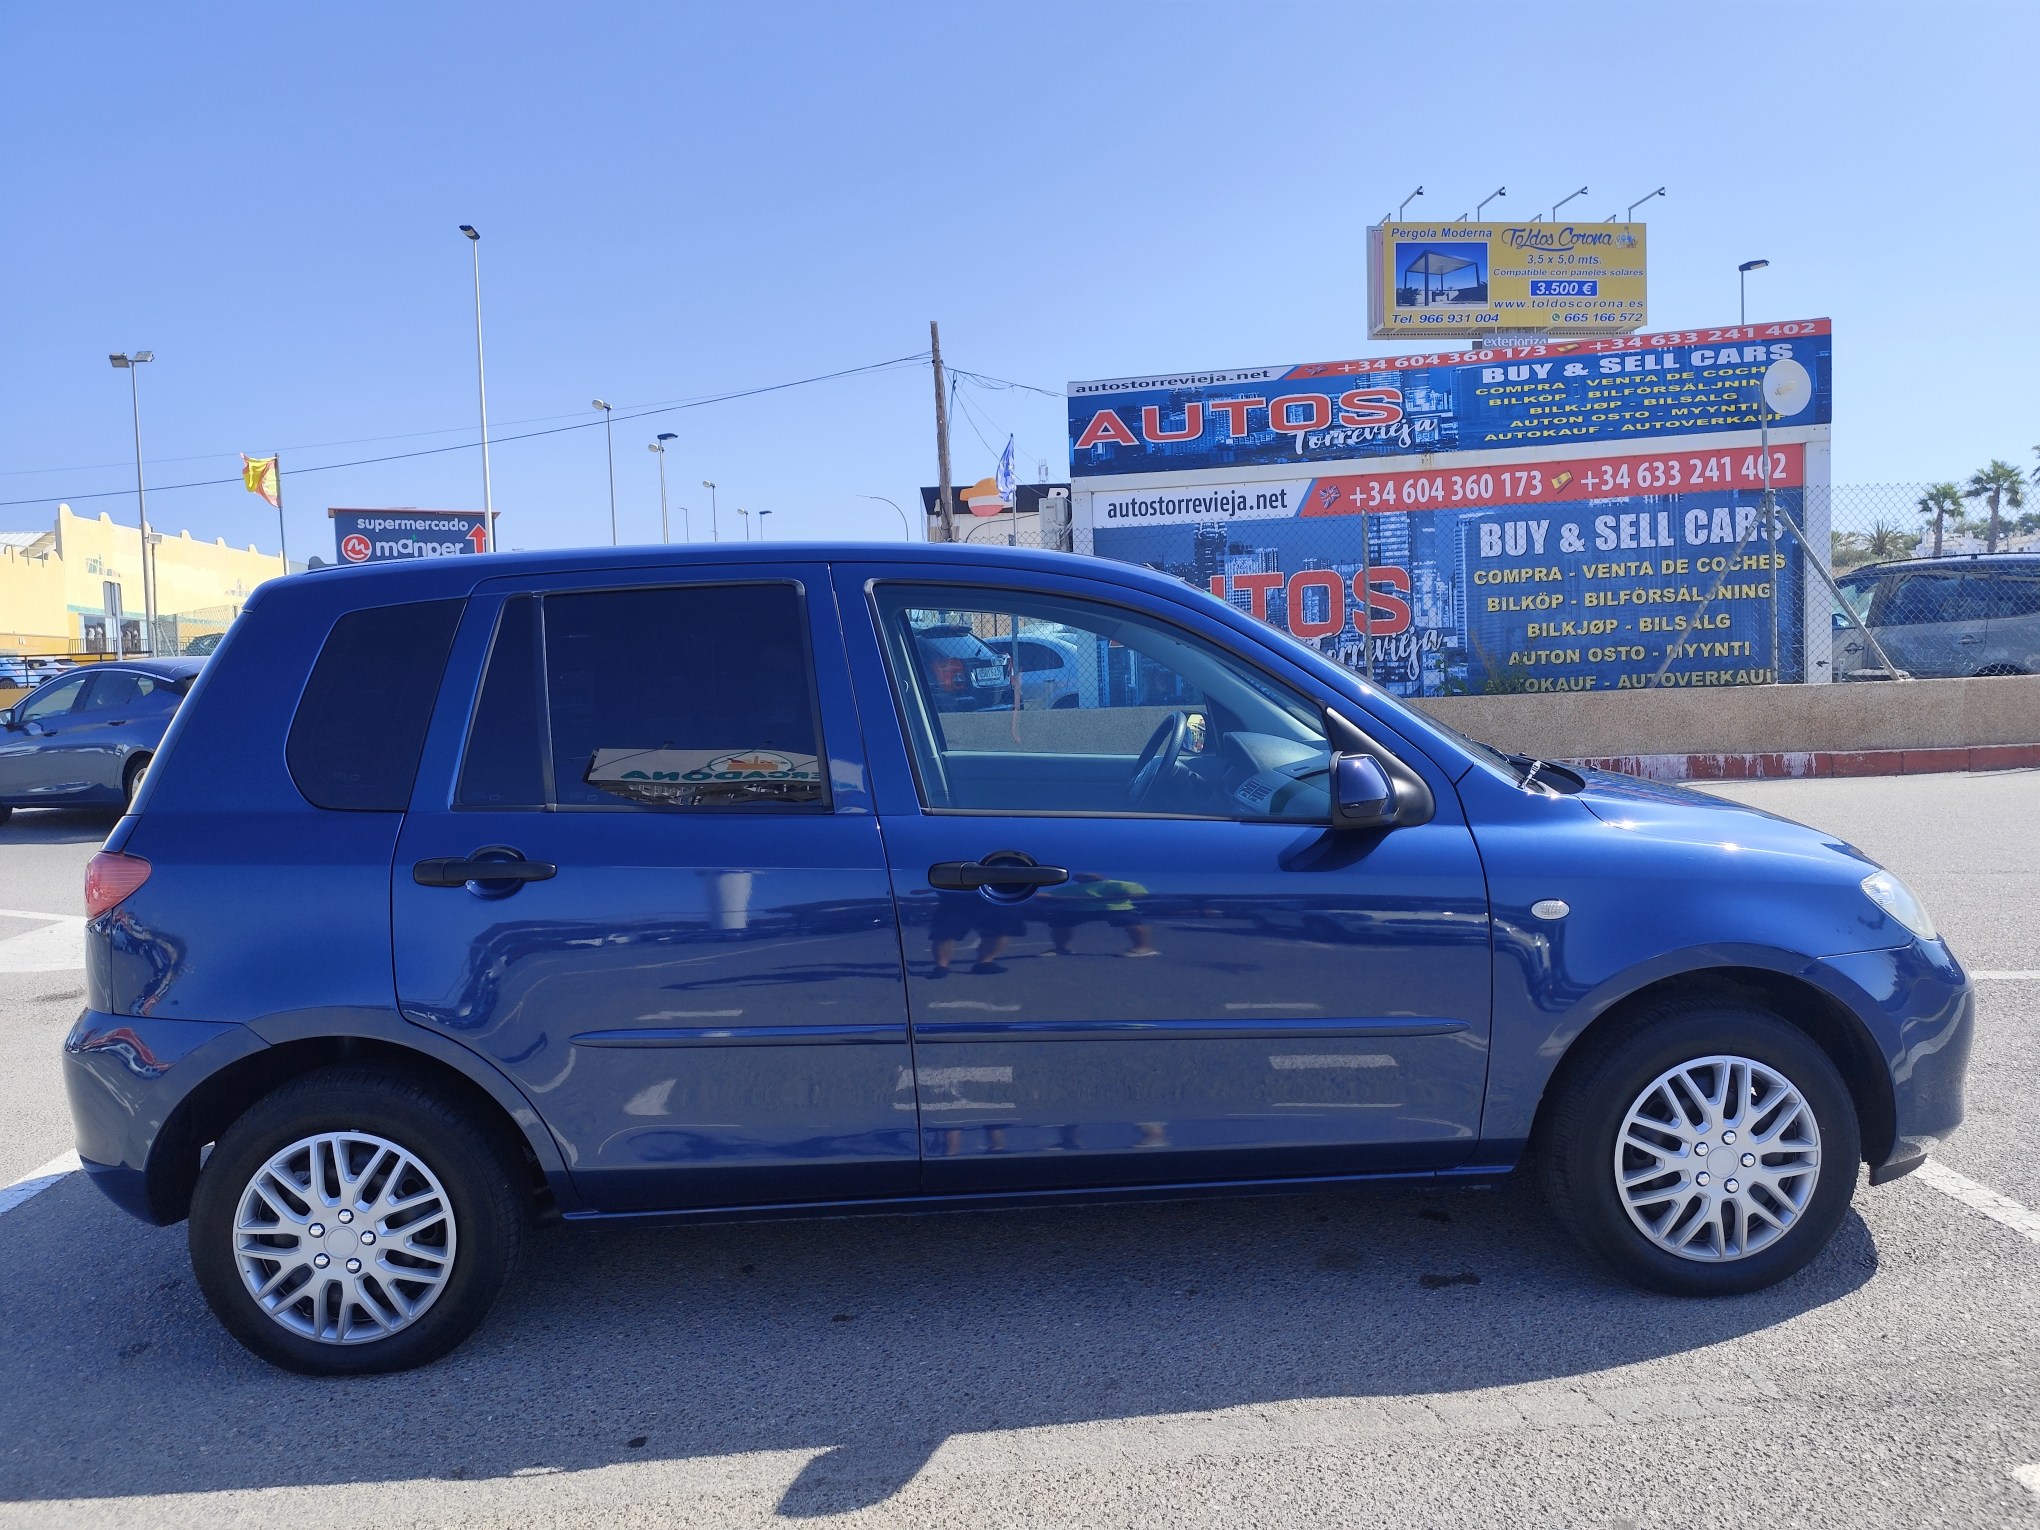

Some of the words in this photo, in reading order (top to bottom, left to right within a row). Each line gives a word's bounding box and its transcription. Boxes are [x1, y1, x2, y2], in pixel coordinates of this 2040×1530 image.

[1391, 227, 1437, 240] Pérgola
[1441, 227, 1492, 238] Moderna
[1558, 227, 1613, 247] Corona
[1527, 254, 1544, 266] 3,5
[1557, 254, 1575, 265] 5,0
[1577, 254, 1602, 265] mts.
[1493, 268, 1547, 277] Compatible
[1570, 268, 1607, 278] paneles
[1609, 268, 1644, 276] solares
[1536, 282, 1579, 295] 3.500
[1582, 282, 1594, 294] €
[1493, 299, 1644, 308] www.toldoscorona.es
[1391, 314, 1415, 324] Tel.
[1419, 313, 1444, 324] 966
[1447, 313, 1471, 324] 931
[1475, 313, 1499, 323] 004
[1564, 313, 1589, 322] 665
[1592, 313, 1616, 322] 166
[1619, 313, 1643, 322] 572
[1075, 369, 1271, 394] autostorrevieja.net
[1337, 359, 1388, 373] +34
[1394, 354, 1441, 369] 604
[1447, 349, 1494, 364] 360
[1501, 345, 1547, 359] 173
[1588, 337, 1643, 351] +34
[1650, 332, 1699, 346] 633
[1707, 327, 1756, 342] 241
[1764, 322, 1816, 336] 402
[1482, 362, 1553, 384] BUY
[1562, 362, 1590, 377] &
[1599, 352, 1680, 374] SELL
[1690, 343, 1794, 367] CARS
[1475, 382, 1566, 396] COMPRA
[1586, 374, 1659, 387] VENTA
[1666, 371, 1695, 380] DE
[1702, 365, 1767, 378] COCH
[1488, 393, 1567, 407] BILKÖP
[1588, 378, 1762, 399] BILFÖRSÄLJNIN
[1529, 401, 1622, 415] BILKJØP
[1643, 392, 1738, 406] BILSALG
[1073, 387, 1403, 450] AUTOS
[1510, 415, 1584, 428] AUTON
[1591, 410, 1650, 422] OSTO
[1671, 402, 1758, 416] MYYNTI
[1287, 417, 1438, 455] Torrevieja
[1484, 426, 1600, 442] AUTOKAUF
[1107, 488, 1288, 519] autostorrevieja.net
[1349, 480, 1397, 507] +34
[1402, 477, 1445, 503] 604
[1451, 473, 1494, 501] 360
[1501, 470, 1543, 497] 173
[1580, 463, 1631, 491] +34
[1637, 460, 1681, 487] 633
[1689, 456, 1732, 484] 241
[1741, 452, 1787, 481] 402
[357, 517, 469, 532] supermercado
[1479, 519, 1551, 559] BUY
[1559, 522, 1586, 553] &
[1594, 511, 1675, 551] SELL
[1684, 504, 1784, 546] CARS
[375, 538, 465, 557] manper
[1473, 566, 1563, 586] COMPRA
[1582, 560, 1654, 580] VENTA
[1661, 558, 1689, 575] DE
[1487, 592, 1564, 613] BILKÖP
[1527, 619, 1618, 639] BILKJØP
[1508, 648, 1580, 666] AUTON
[1588, 646, 1646, 662] OSTO
